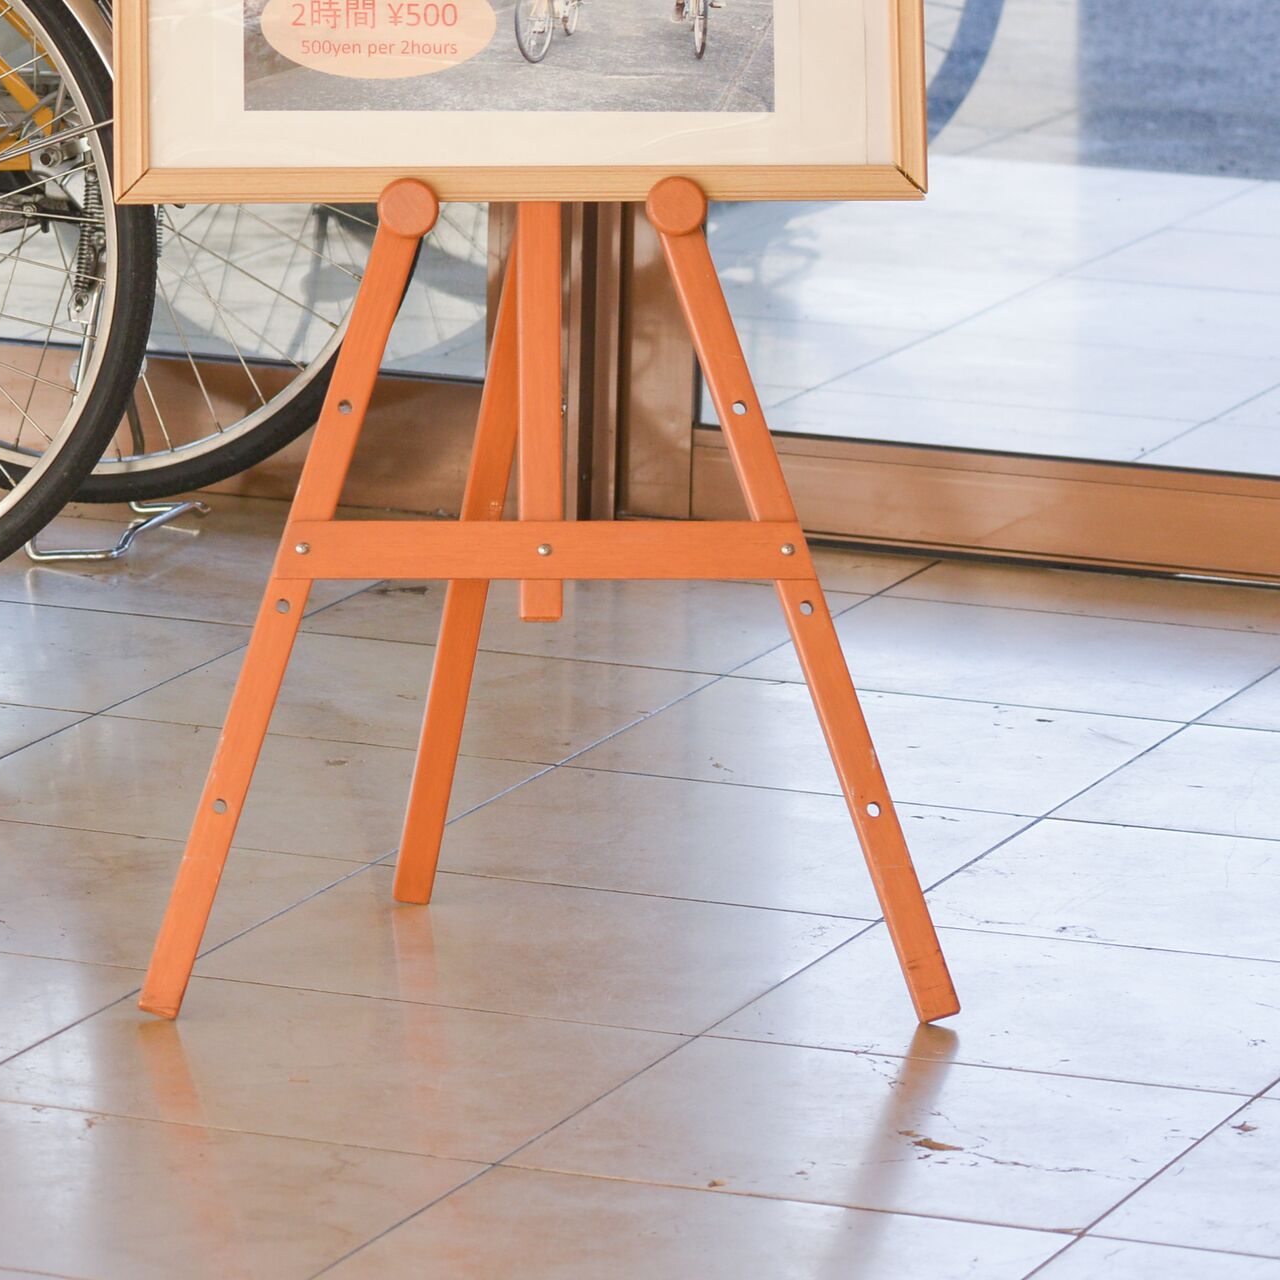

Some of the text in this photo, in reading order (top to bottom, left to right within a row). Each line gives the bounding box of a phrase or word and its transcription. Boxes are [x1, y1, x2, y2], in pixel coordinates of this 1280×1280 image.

[387, 1, 458, 28] ¥500
[300, 39, 458, 58] 500yen per 2hours
